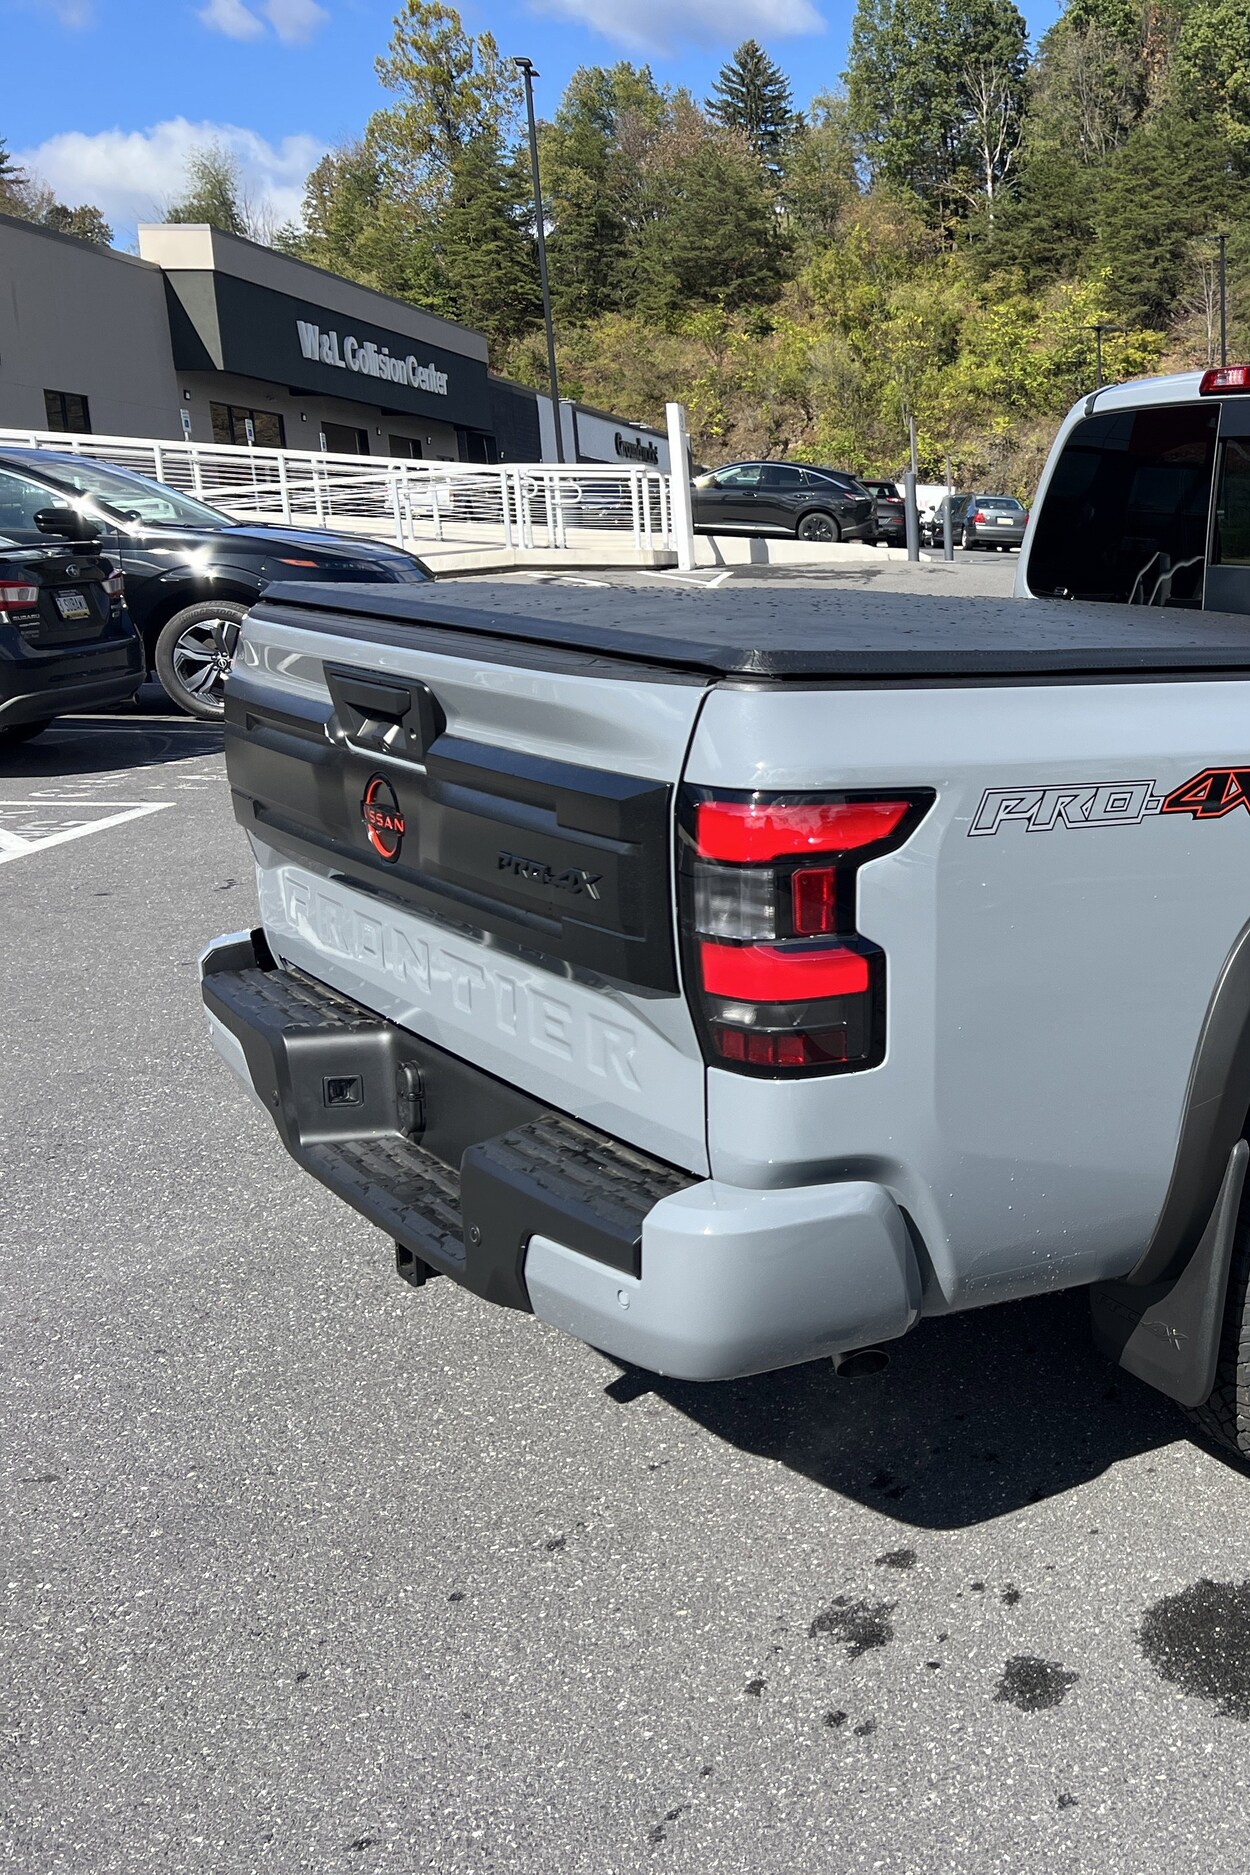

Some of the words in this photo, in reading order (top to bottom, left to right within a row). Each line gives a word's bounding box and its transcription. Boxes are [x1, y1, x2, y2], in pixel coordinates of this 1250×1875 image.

[296, 320, 346, 368] W&L
[344, 336, 408, 385] Collision
[405, 355, 448, 395] Center
[283, 873, 642, 1093] FRONTIER
